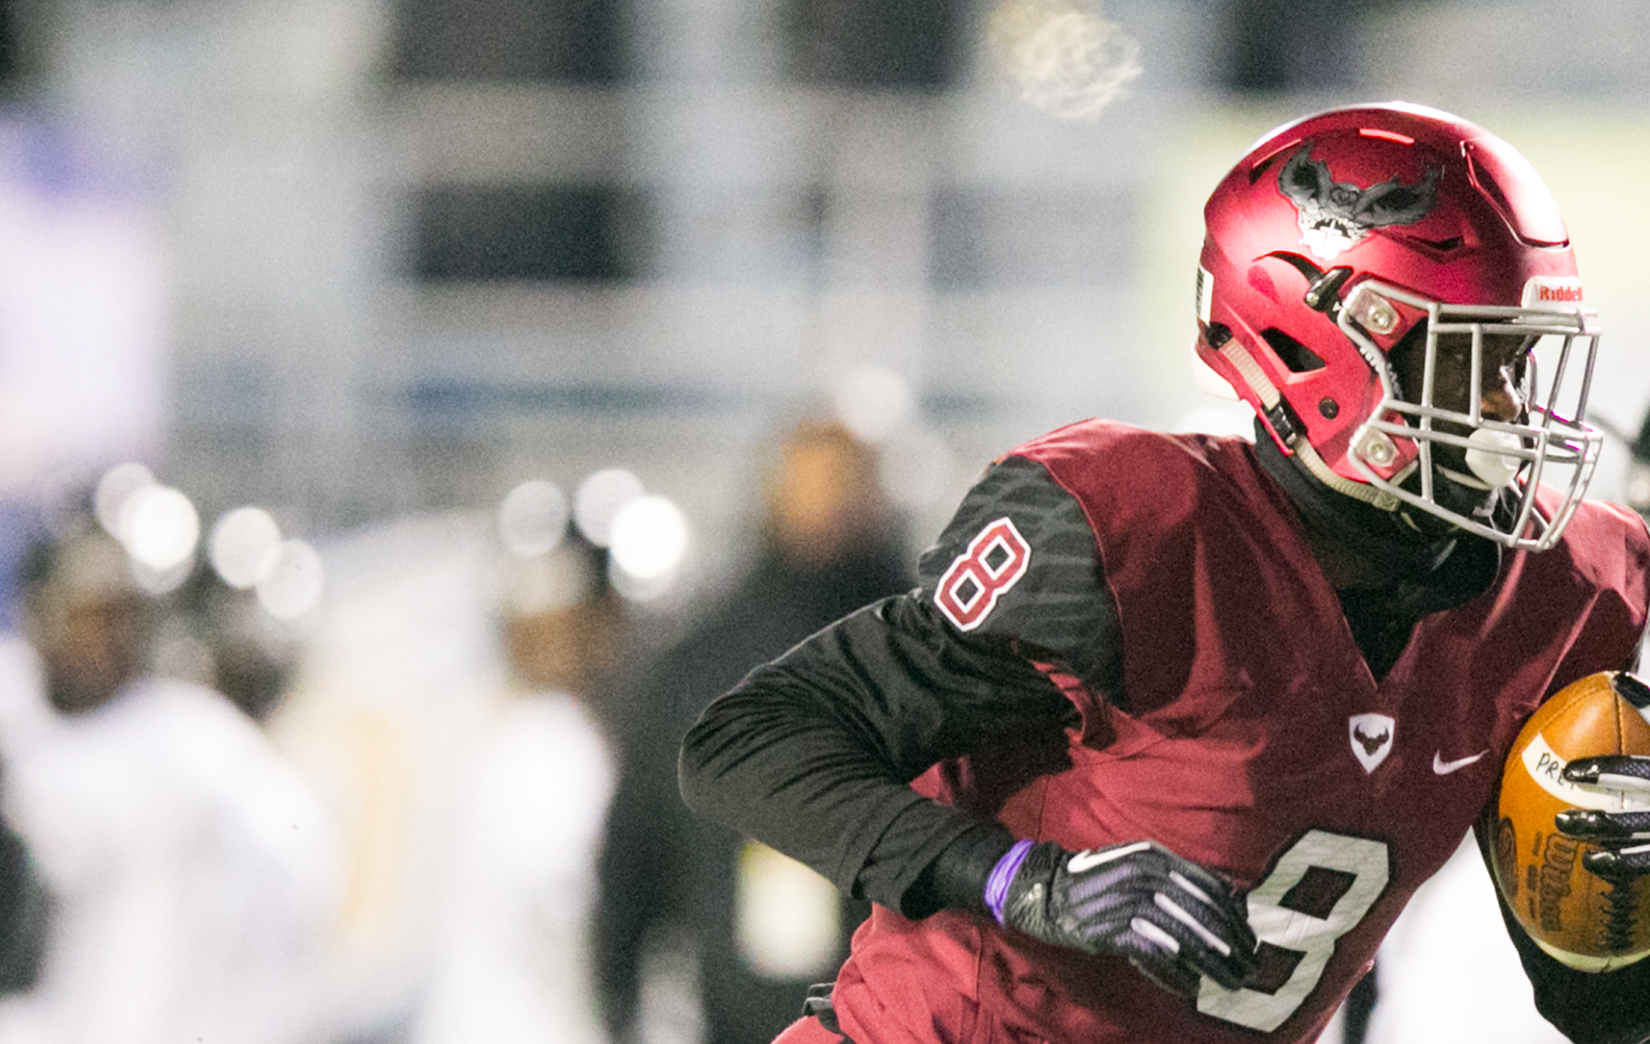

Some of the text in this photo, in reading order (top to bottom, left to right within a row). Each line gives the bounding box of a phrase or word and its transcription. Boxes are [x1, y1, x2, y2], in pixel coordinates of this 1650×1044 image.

[934, 516, 1031, 632] 8
[1536, 752, 1575, 790] PRE
[1197, 829, 1390, 1033] 8
